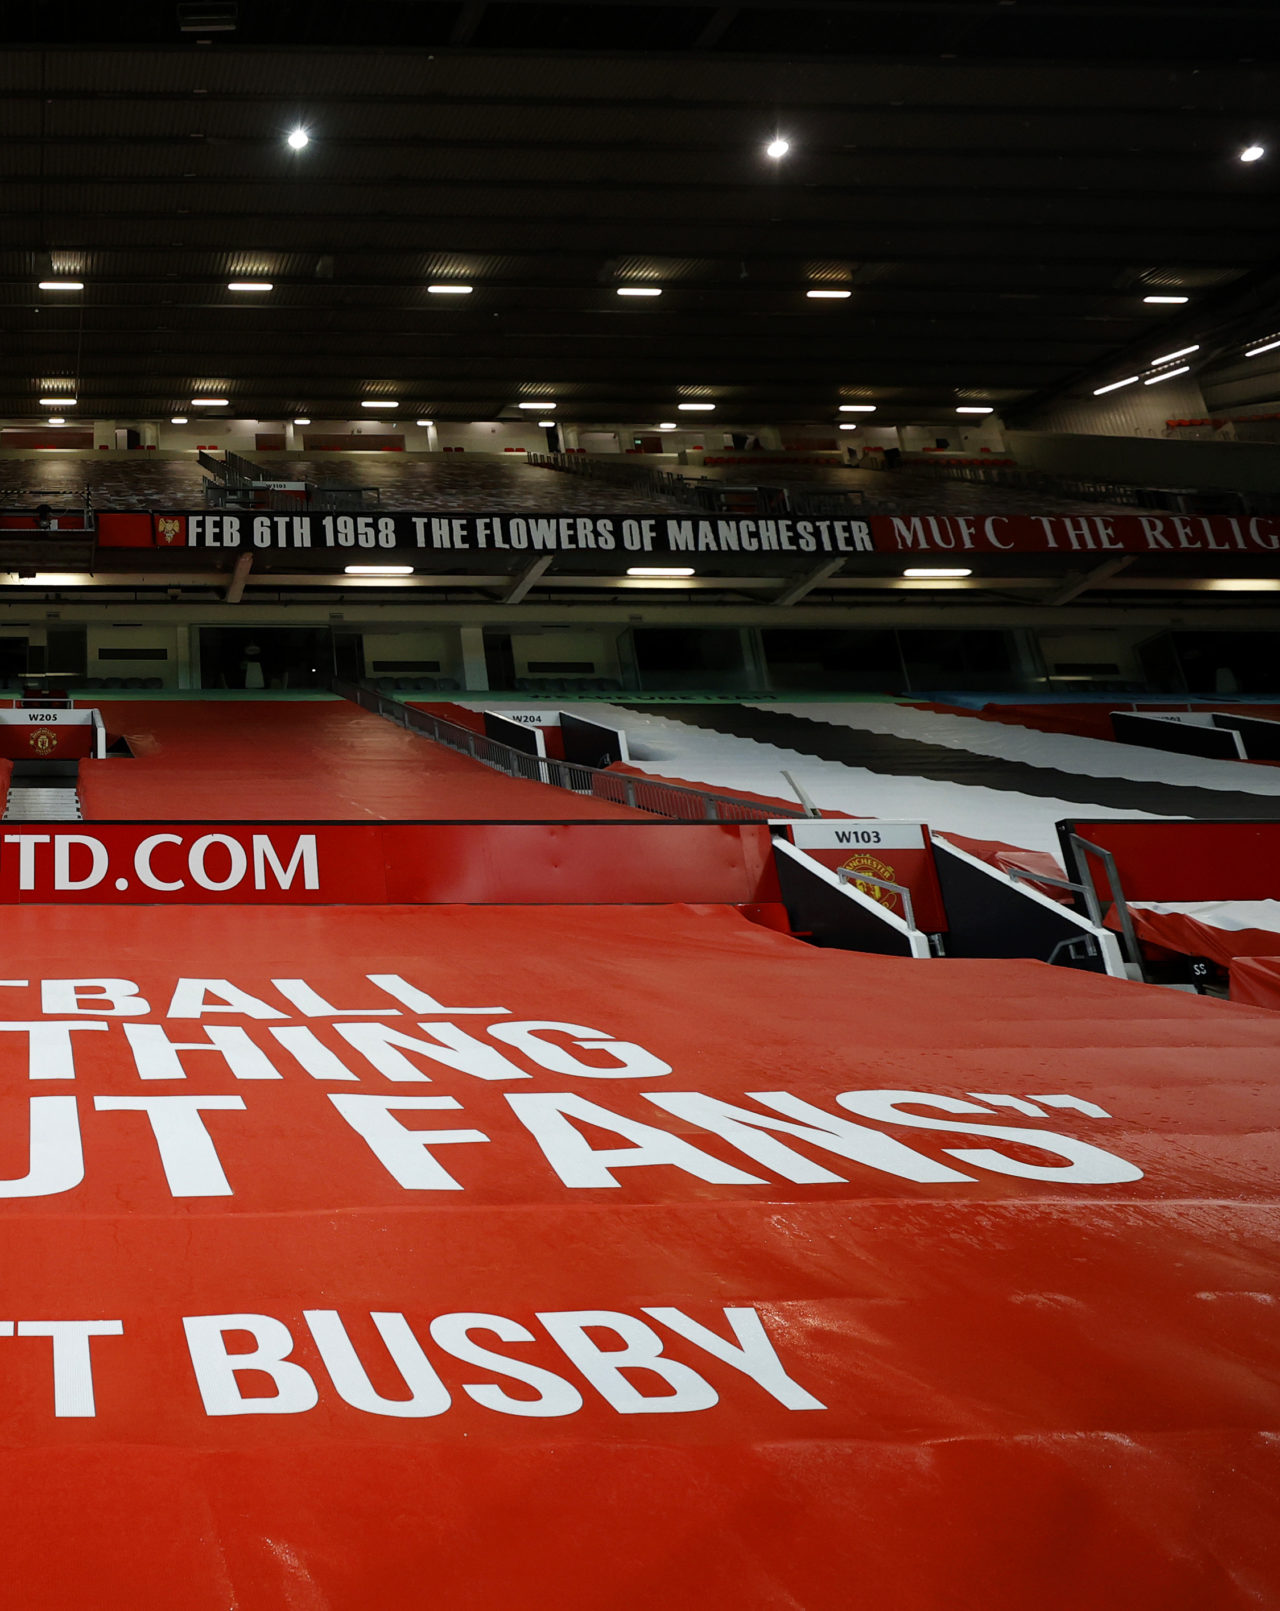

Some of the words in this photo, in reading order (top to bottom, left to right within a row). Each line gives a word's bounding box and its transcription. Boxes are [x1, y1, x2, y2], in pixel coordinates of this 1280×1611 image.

[188, 515, 241, 547] FEB
[252, 516, 312, 548] 6TH
[322, 516, 397, 549] 1958
[411, 517, 470, 549] THE
[475, 517, 616, 550] FLOWERS
[622, 519, 657, 551] OF
[666, 519, 874, 551] MANCHESTER
[889, 516, 1015, 550] MUFC
[1030, 516, 1124, 550] THE
[1137, 516, 1280, 550] RELIG
[29, 714, 58, 722] W205
[512, 715, 542, 723] W204
[835, 831, 882, 844] W103
[182, 1306, 829, 1419] BUSBY
